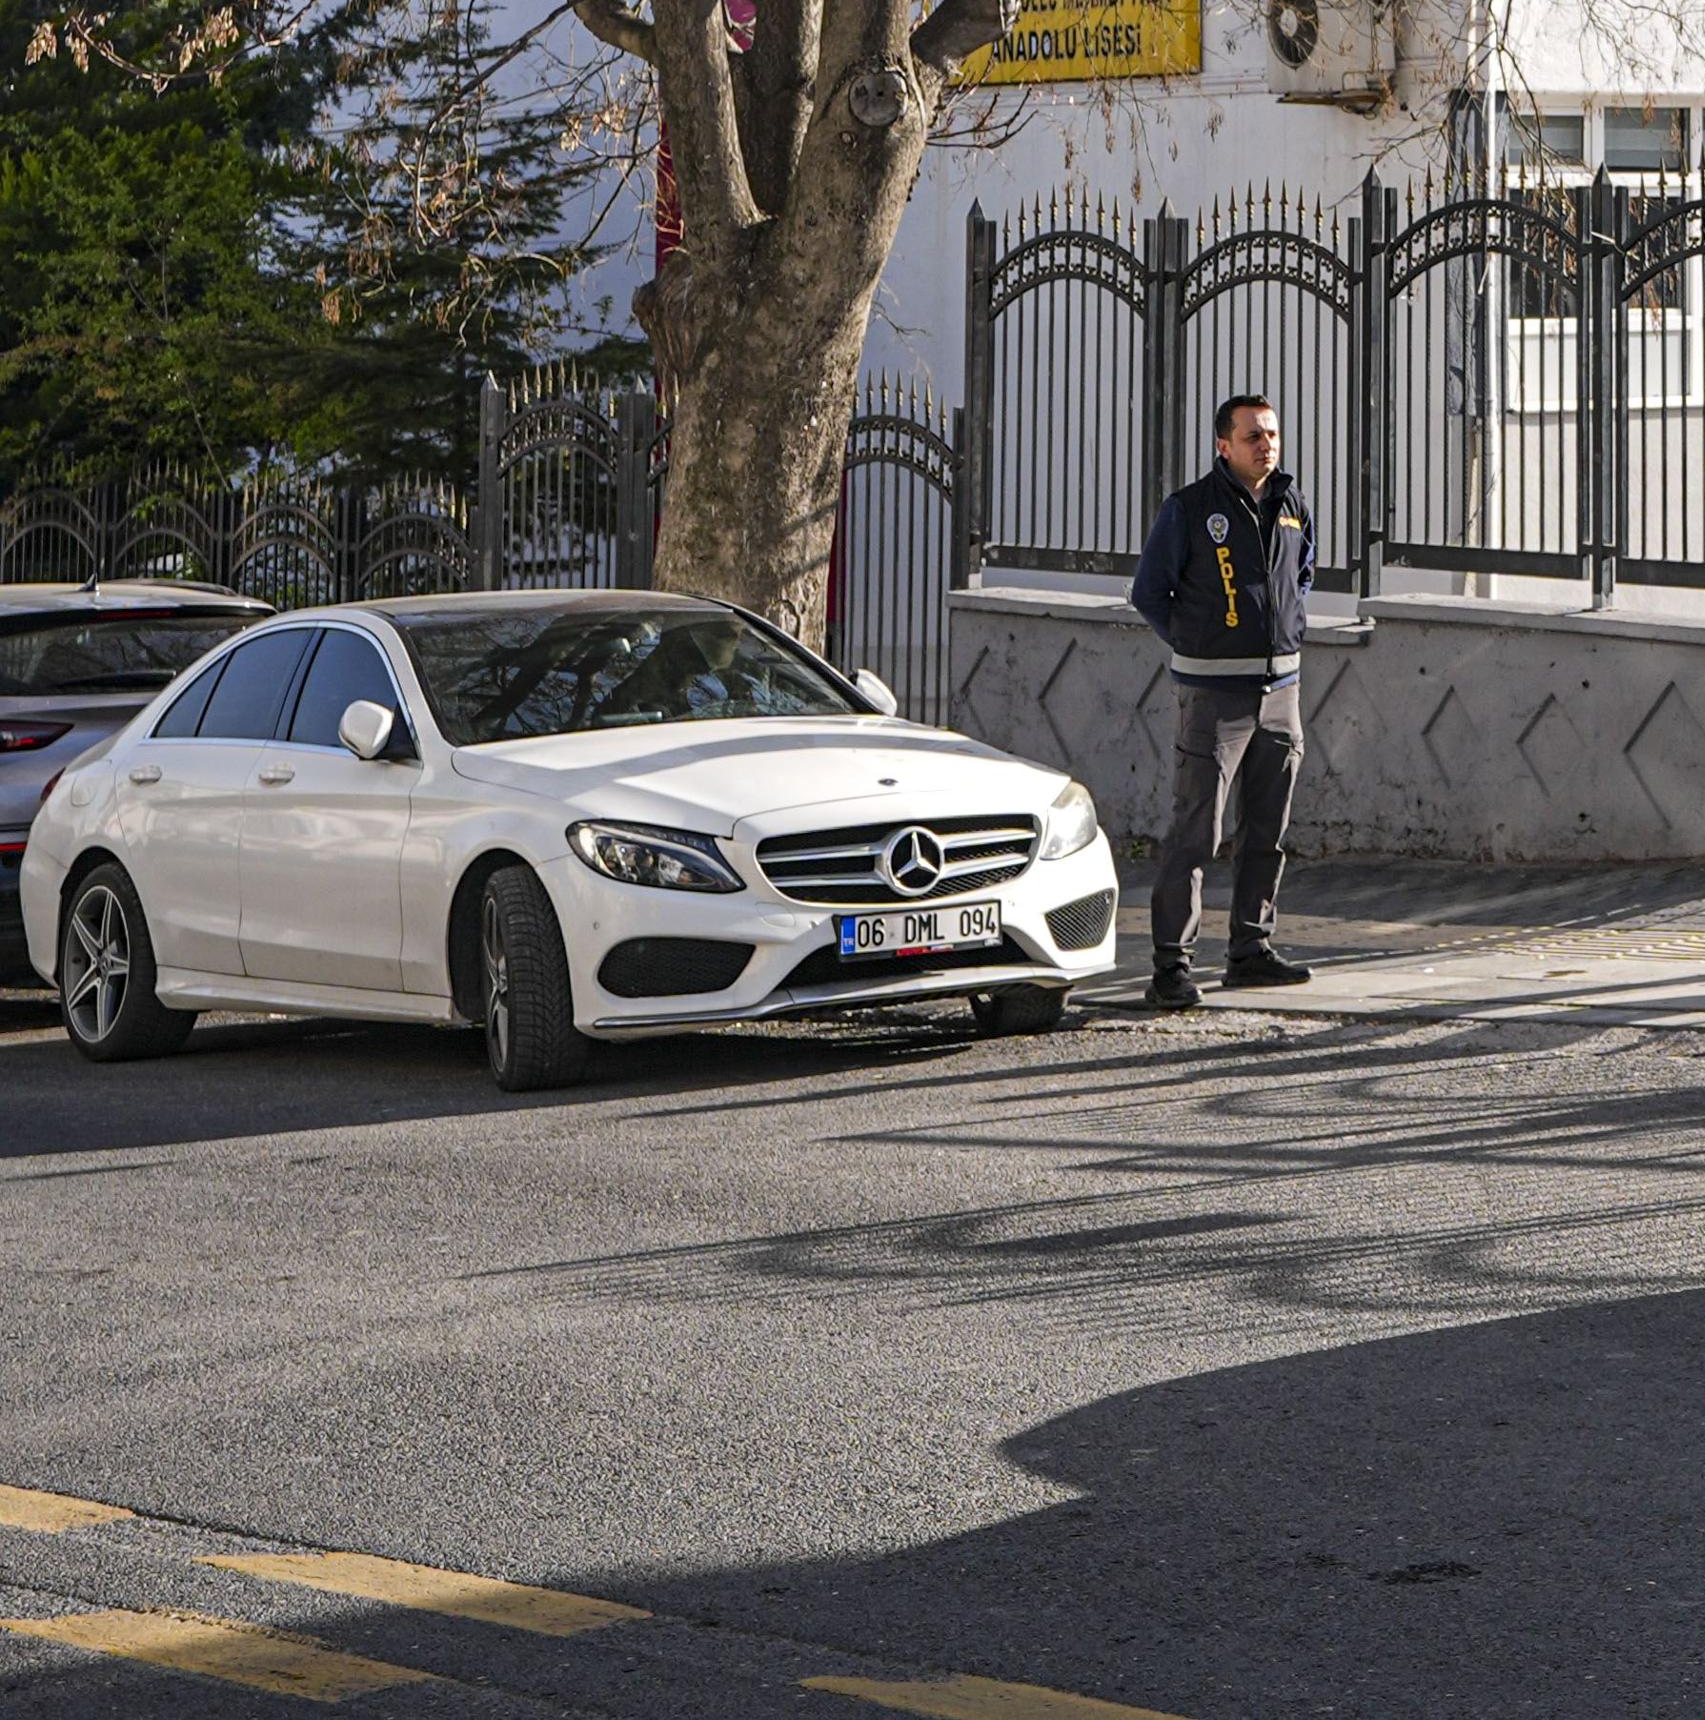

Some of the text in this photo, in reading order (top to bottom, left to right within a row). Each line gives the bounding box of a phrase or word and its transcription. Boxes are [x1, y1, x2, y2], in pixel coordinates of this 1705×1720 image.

[991, 26, 1077, 62] ANADOLU
[857, 919, 885, 948] 06
[904, 913, 945, 944] DML
[959, 907, 997, 937] 094
